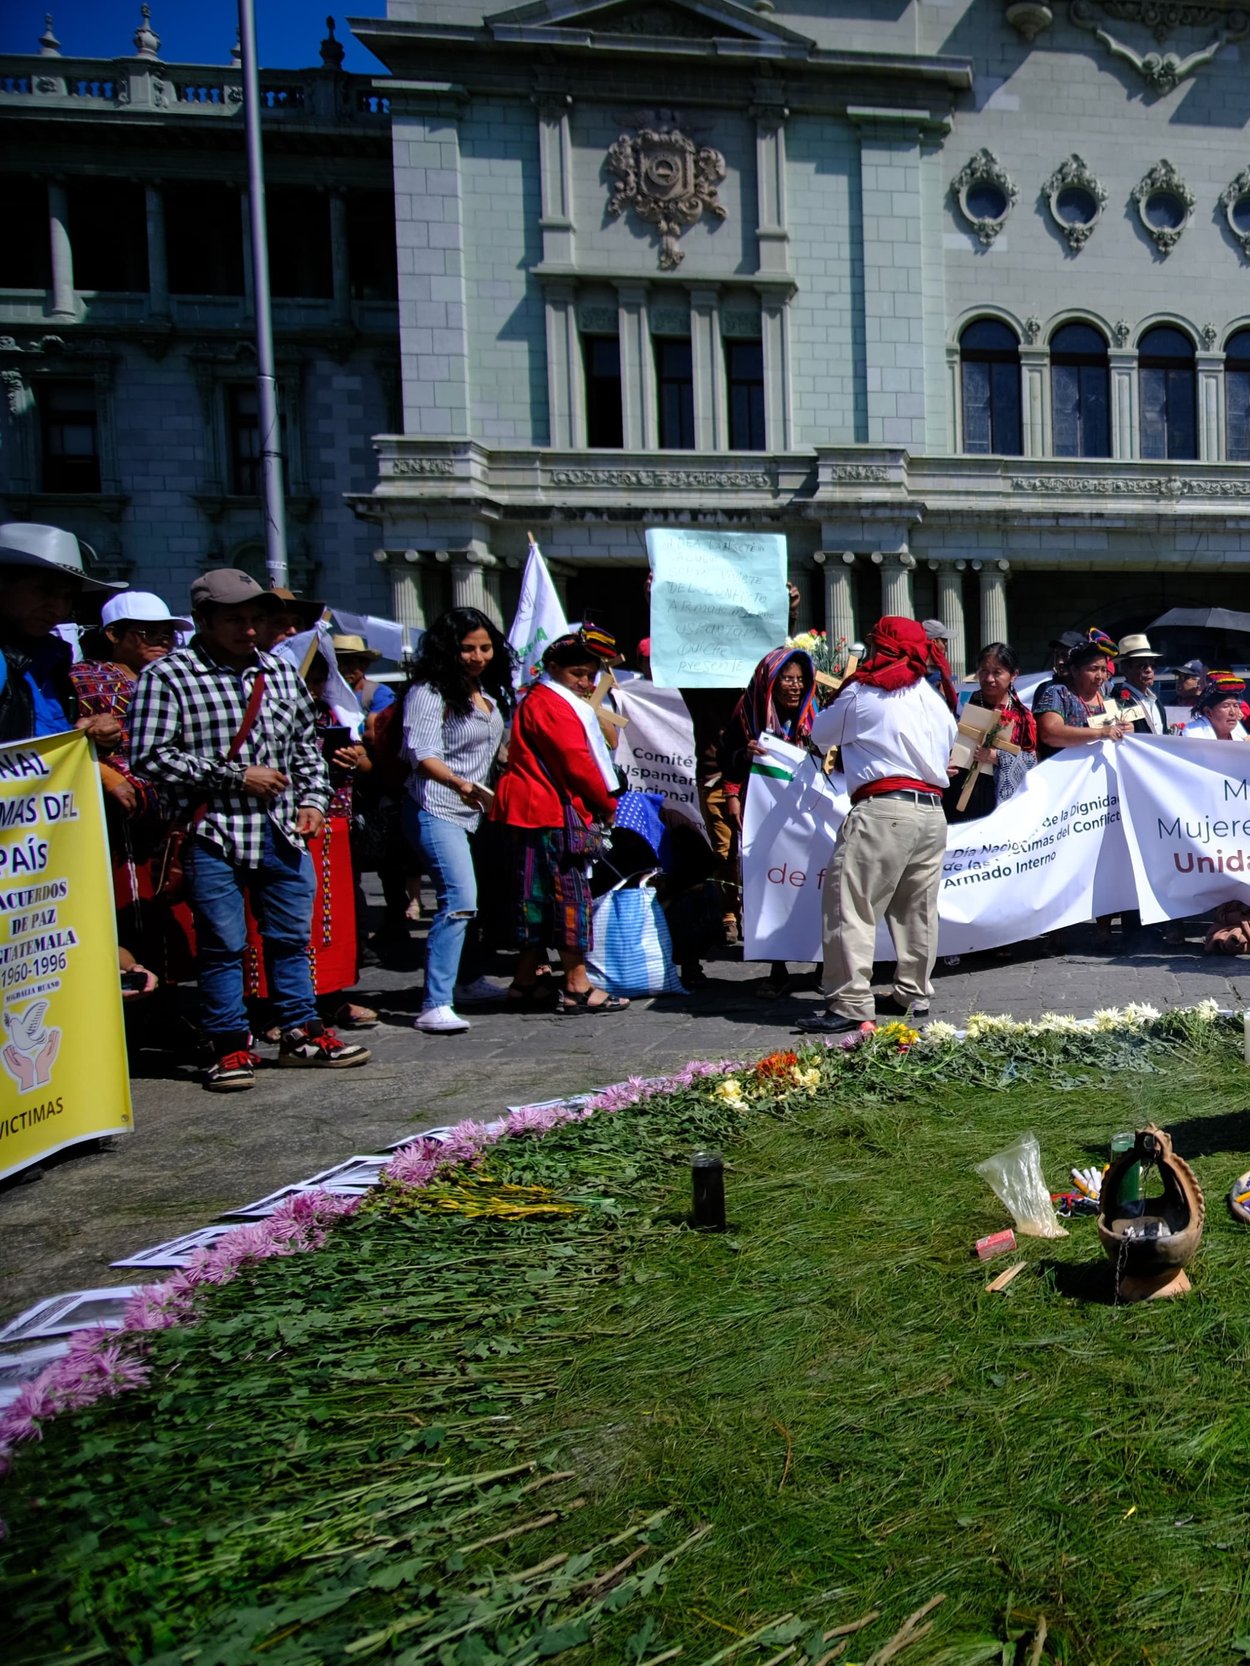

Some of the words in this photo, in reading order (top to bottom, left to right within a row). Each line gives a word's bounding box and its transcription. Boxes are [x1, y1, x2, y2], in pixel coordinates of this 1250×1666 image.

[633, 747, 693, 768] Comité
[43, 794, 78, 820] DEL
[1070, 795, 1119, 817] Dignida
[1056, 824, 1070, 841] del
[1073, 811, 1121, 833] Conflict
[767, 862, 807, 887] de
[944, 864, 1012, 889] Armado
[1016, 850, 1057, 874] Interno
[12, 916, 29, 935] DE
[31, 908, 56, 929] PAZ
[1, 952, 67, 988] 1960-1996
